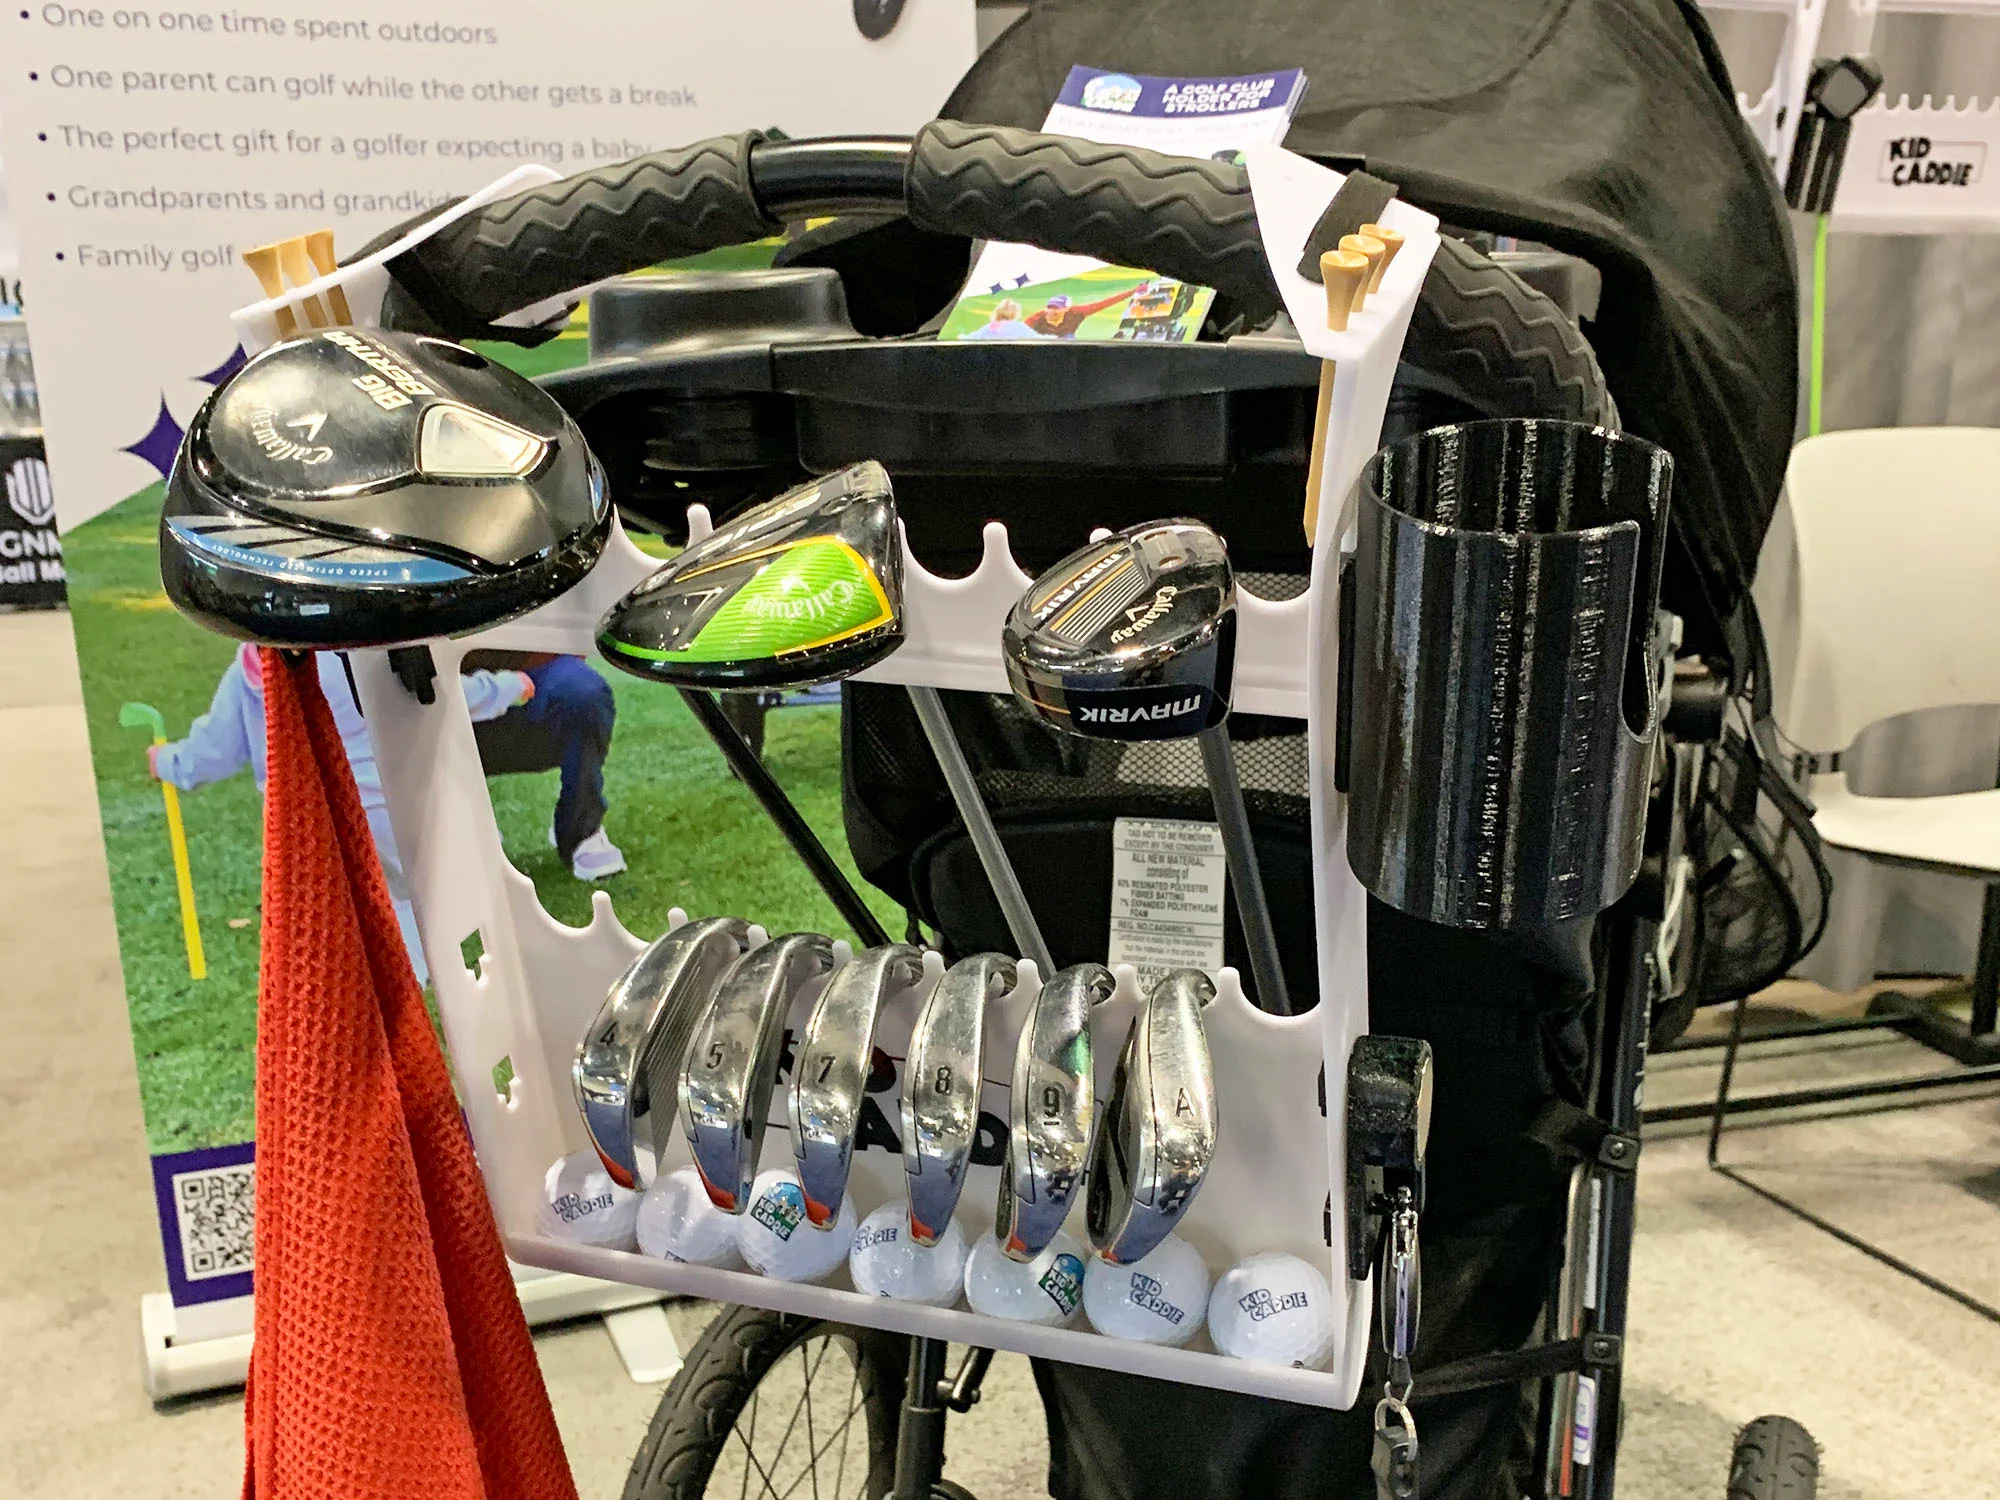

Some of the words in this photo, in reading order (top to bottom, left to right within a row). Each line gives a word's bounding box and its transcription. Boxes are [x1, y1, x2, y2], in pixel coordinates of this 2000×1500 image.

[42, 3, 104, 28] One
[112, 10, 150, 29] on
[158, 12, 213, 32] one
[221, 10, 286, 36] time
[294, 17, 369, 41] spent
[378, 20, 497, 45] outdoors
[50, 64, 113, 88] One
[122, 70, 217, 93] parent
[225, 75, 276, 93] can
[283, 73, 335, 100] golf
[342, 76, 414, 100] while
[422, 79, 465, 101] the
[472, 80, 539, 102] other
[548, 83, 603, 107] gets
[609, 87, 622, 105] a
[629, 84, 697, 107] break
[58, 124, 113, 148] The
[123, 127, 224, 152] perfect
[231, 129, 279, 157] gift
[286, 129, 321, 152] for
[330, 136, 345, 153] a
[353, 133, 428, 159] golfer
[437, 136, 563, 162] expecting
[571, 141, 585, 159] a
[1889, 137, 1931, 162] KID
[1892, 160, 1974, 186] CADDIE
[68, 185, 267, 213] Grandparents
[274, 189, 324, 211] and
[333, 189, 453, 216] grandkid
[78, 245, 172, 271] Family
[181, 245, 234, 272] golf
[322, 330, 436, 396] BERTHA
[351, 373, 413, 411] BIG
[210, 544, 275, 568] TECHNOLOGY
[0, 561, 36, 584] all
[349, 567, 389, 578] SPEED
[1033, 553, 1124, 621] MAVRIK
[1110, 585, 1178, 644] Callaway
[1080, 694, 1202, 723] MAVRIK
[1137, 965, 1167, 976] MADE
[600, 1021, 619, 1046] 4
[705, 1042, 726, 1069] 5
[818, 1055, 837, 1083] 7
[935, 1066, 951, 1094] 8
[1043, 1086, 1061, 1117] 9
[1175, 1087, 1197, 1118] A
[552, 1192, 580, 1214] KID
[561, 1193, 615, 1224] CADDIE
[1048, 1268, 1068, 1291] KID
[1131, 1272, 1162, 1299] KID
[1043, 1279, 1074, 1314] CADDIE
[1129, 1289, 1185, 1325] CADDIE
[1239, 1287, 1272, 1313] KID
[1250, 1291, 1309, 1322] CADDIE
